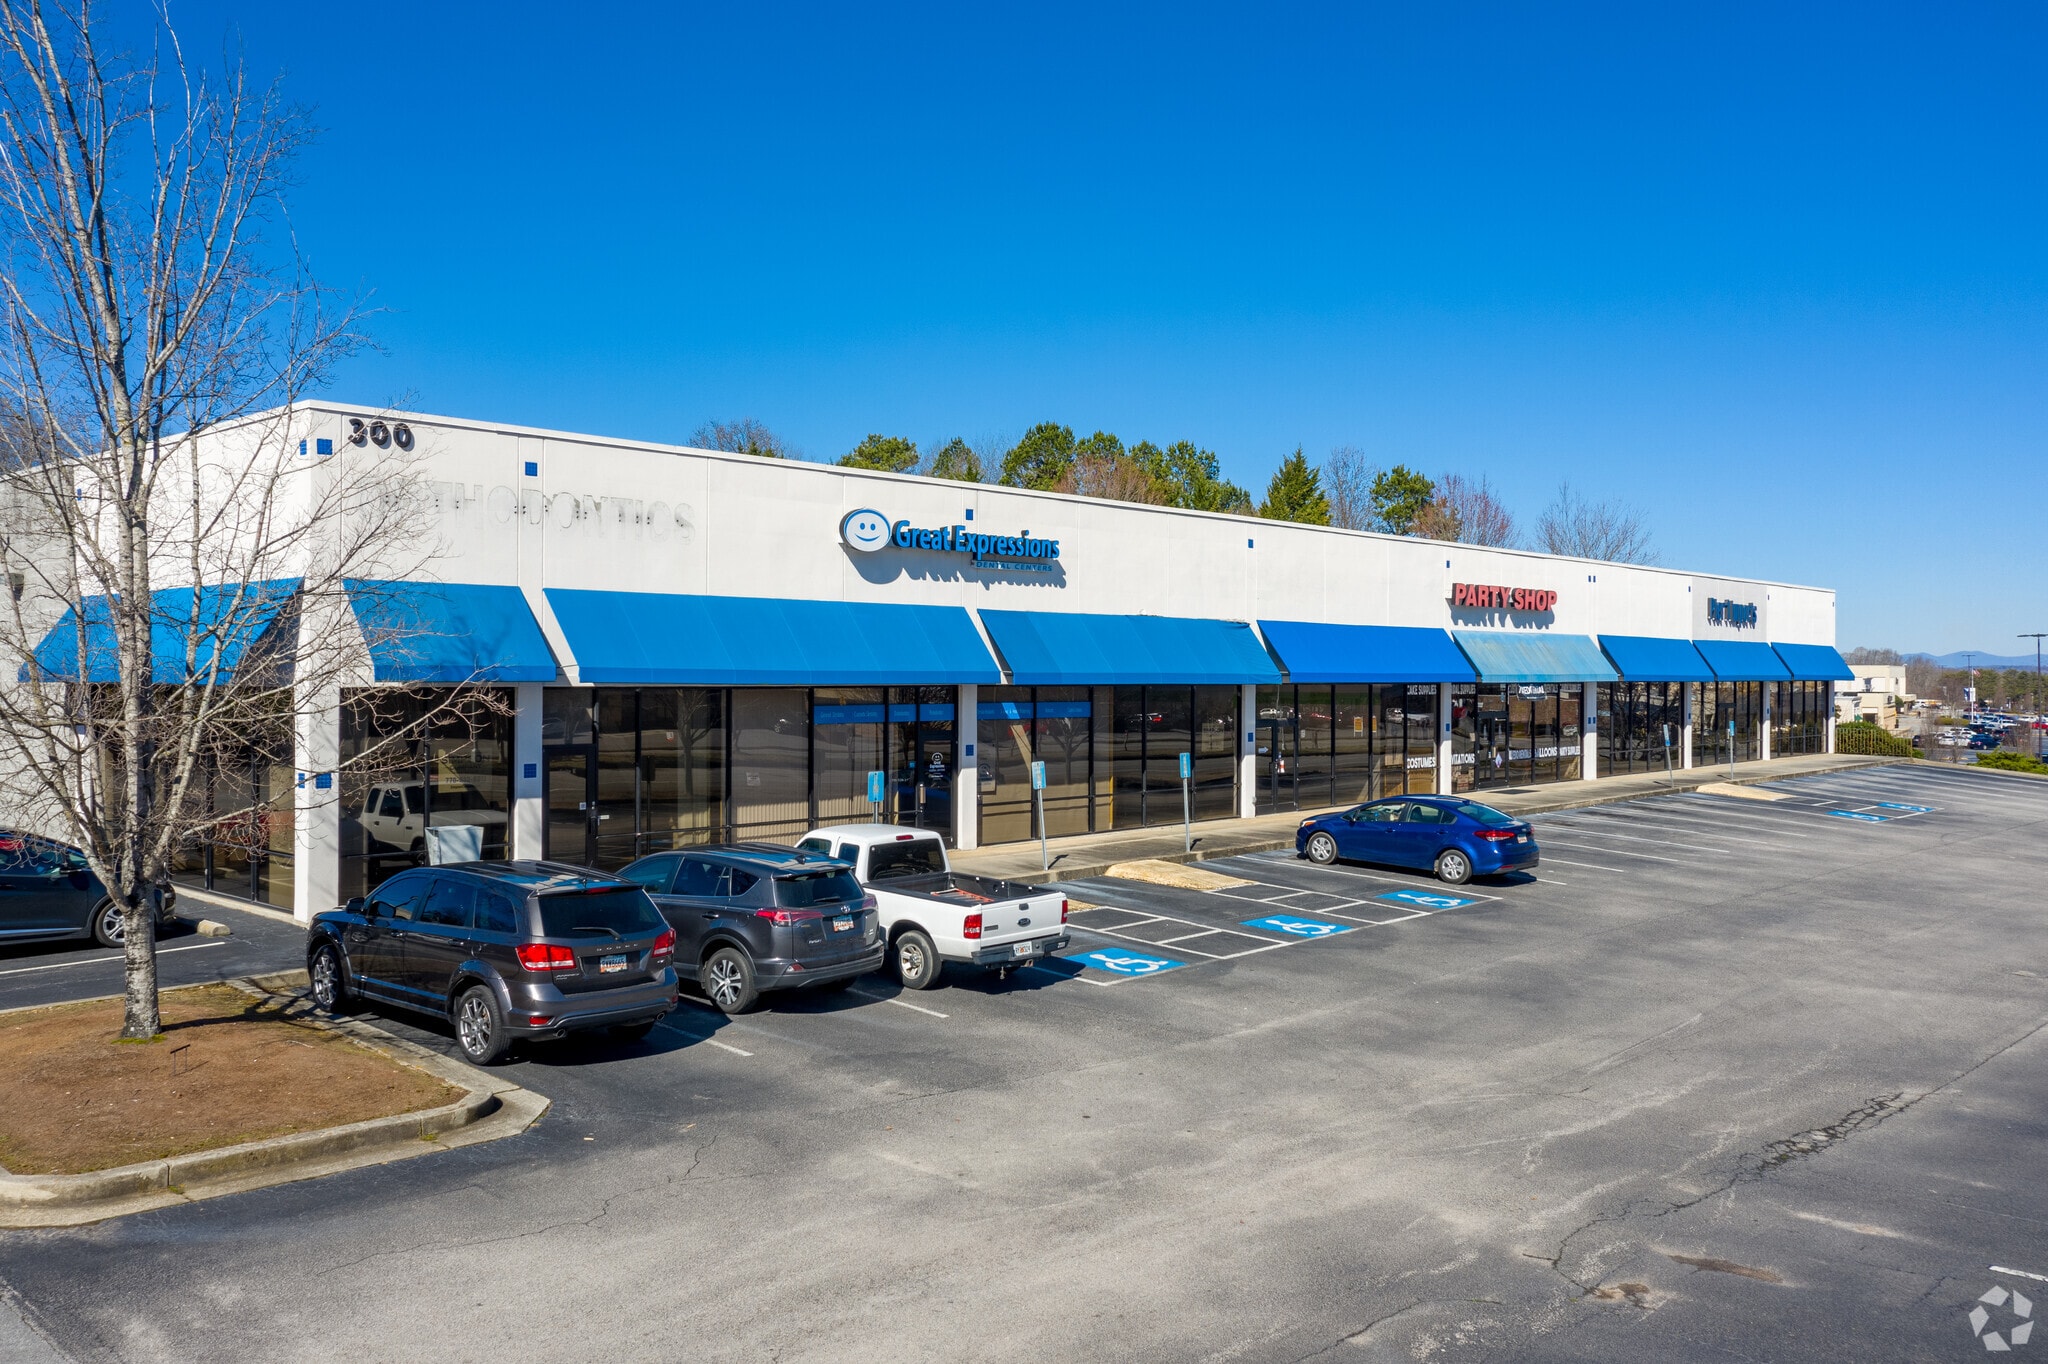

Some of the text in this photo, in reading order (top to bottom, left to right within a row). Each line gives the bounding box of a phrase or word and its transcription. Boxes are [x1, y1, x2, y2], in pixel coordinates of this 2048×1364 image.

[348, 418, 412, 448] 300
[893, 520, 1060, 561] Great Expressions
[975, 561, 1053, 572] DENTAL CENTERS
[1452, 583, 1557, 611] PARTY SHOP
[1407, 756, 1436, 768] COSTUMES
